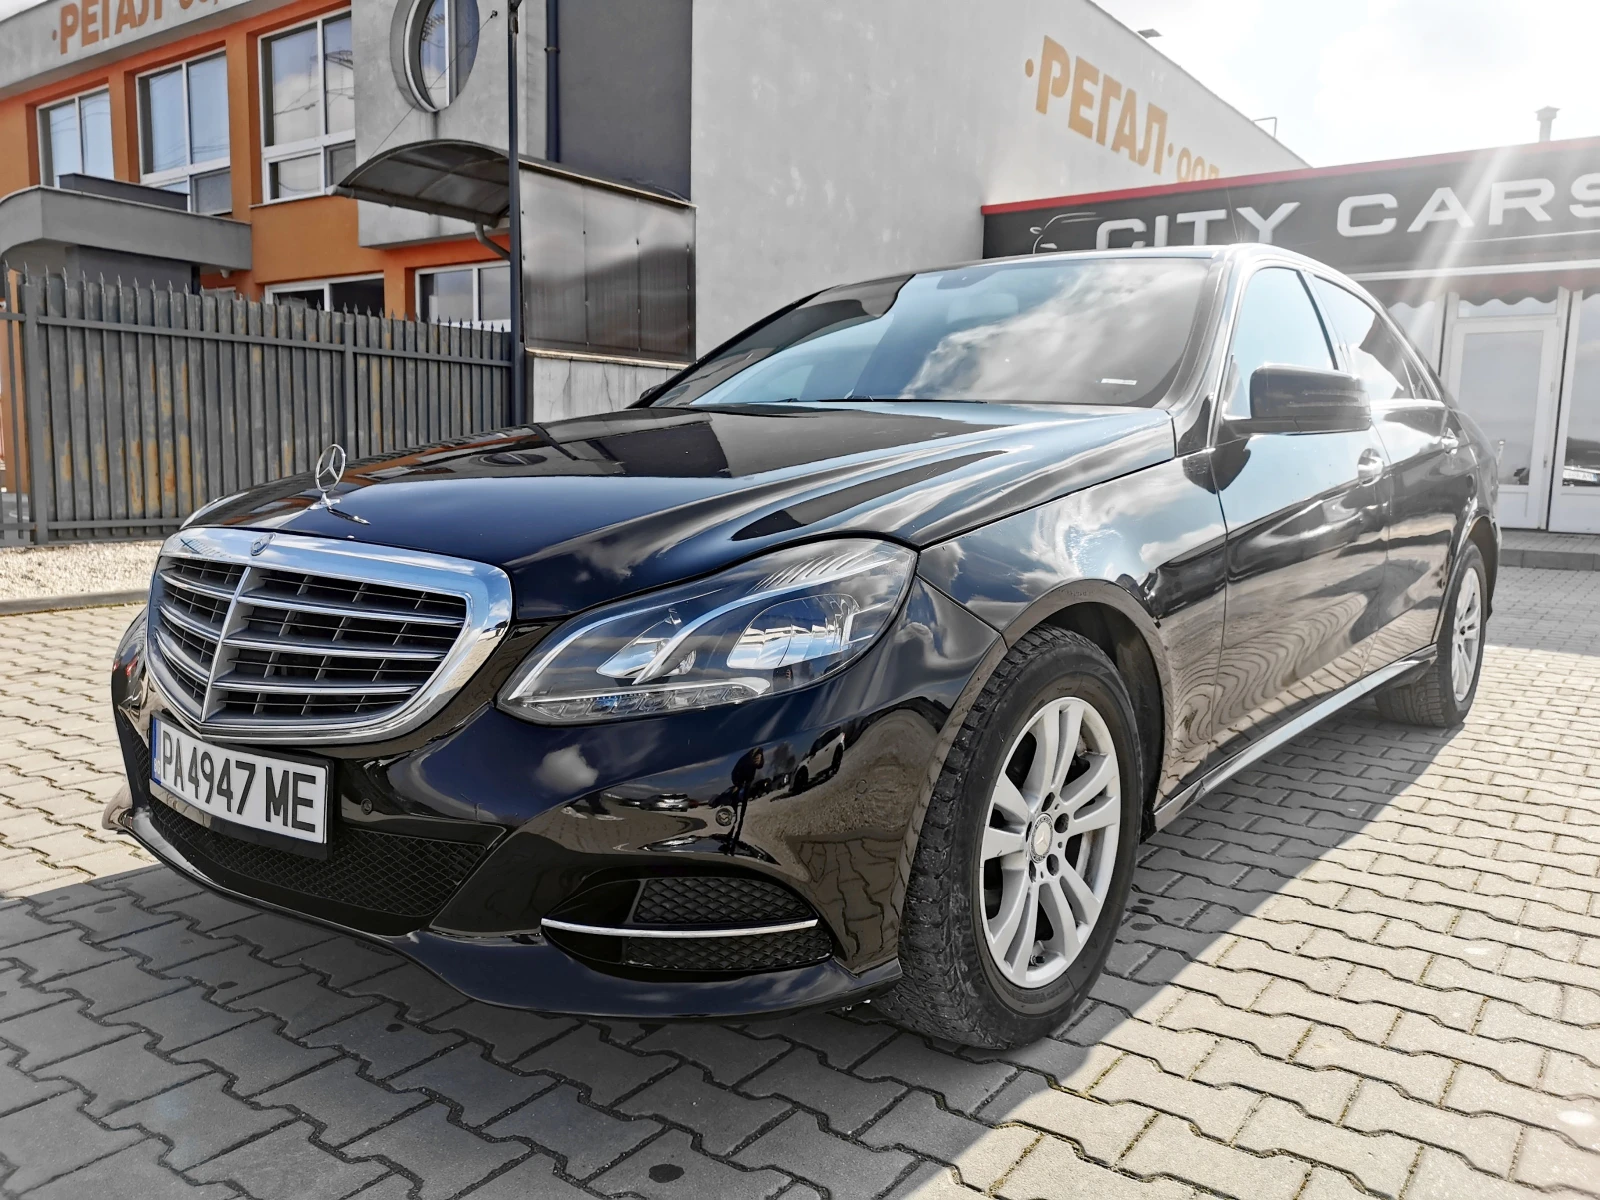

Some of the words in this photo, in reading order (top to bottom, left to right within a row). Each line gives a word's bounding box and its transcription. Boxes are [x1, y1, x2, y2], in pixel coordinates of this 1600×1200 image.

[1035, 35, 1168, 175] РЕГАЛ
[1096, 202, 1300, 250] CITY
[265, 766, 317, 833] ME
